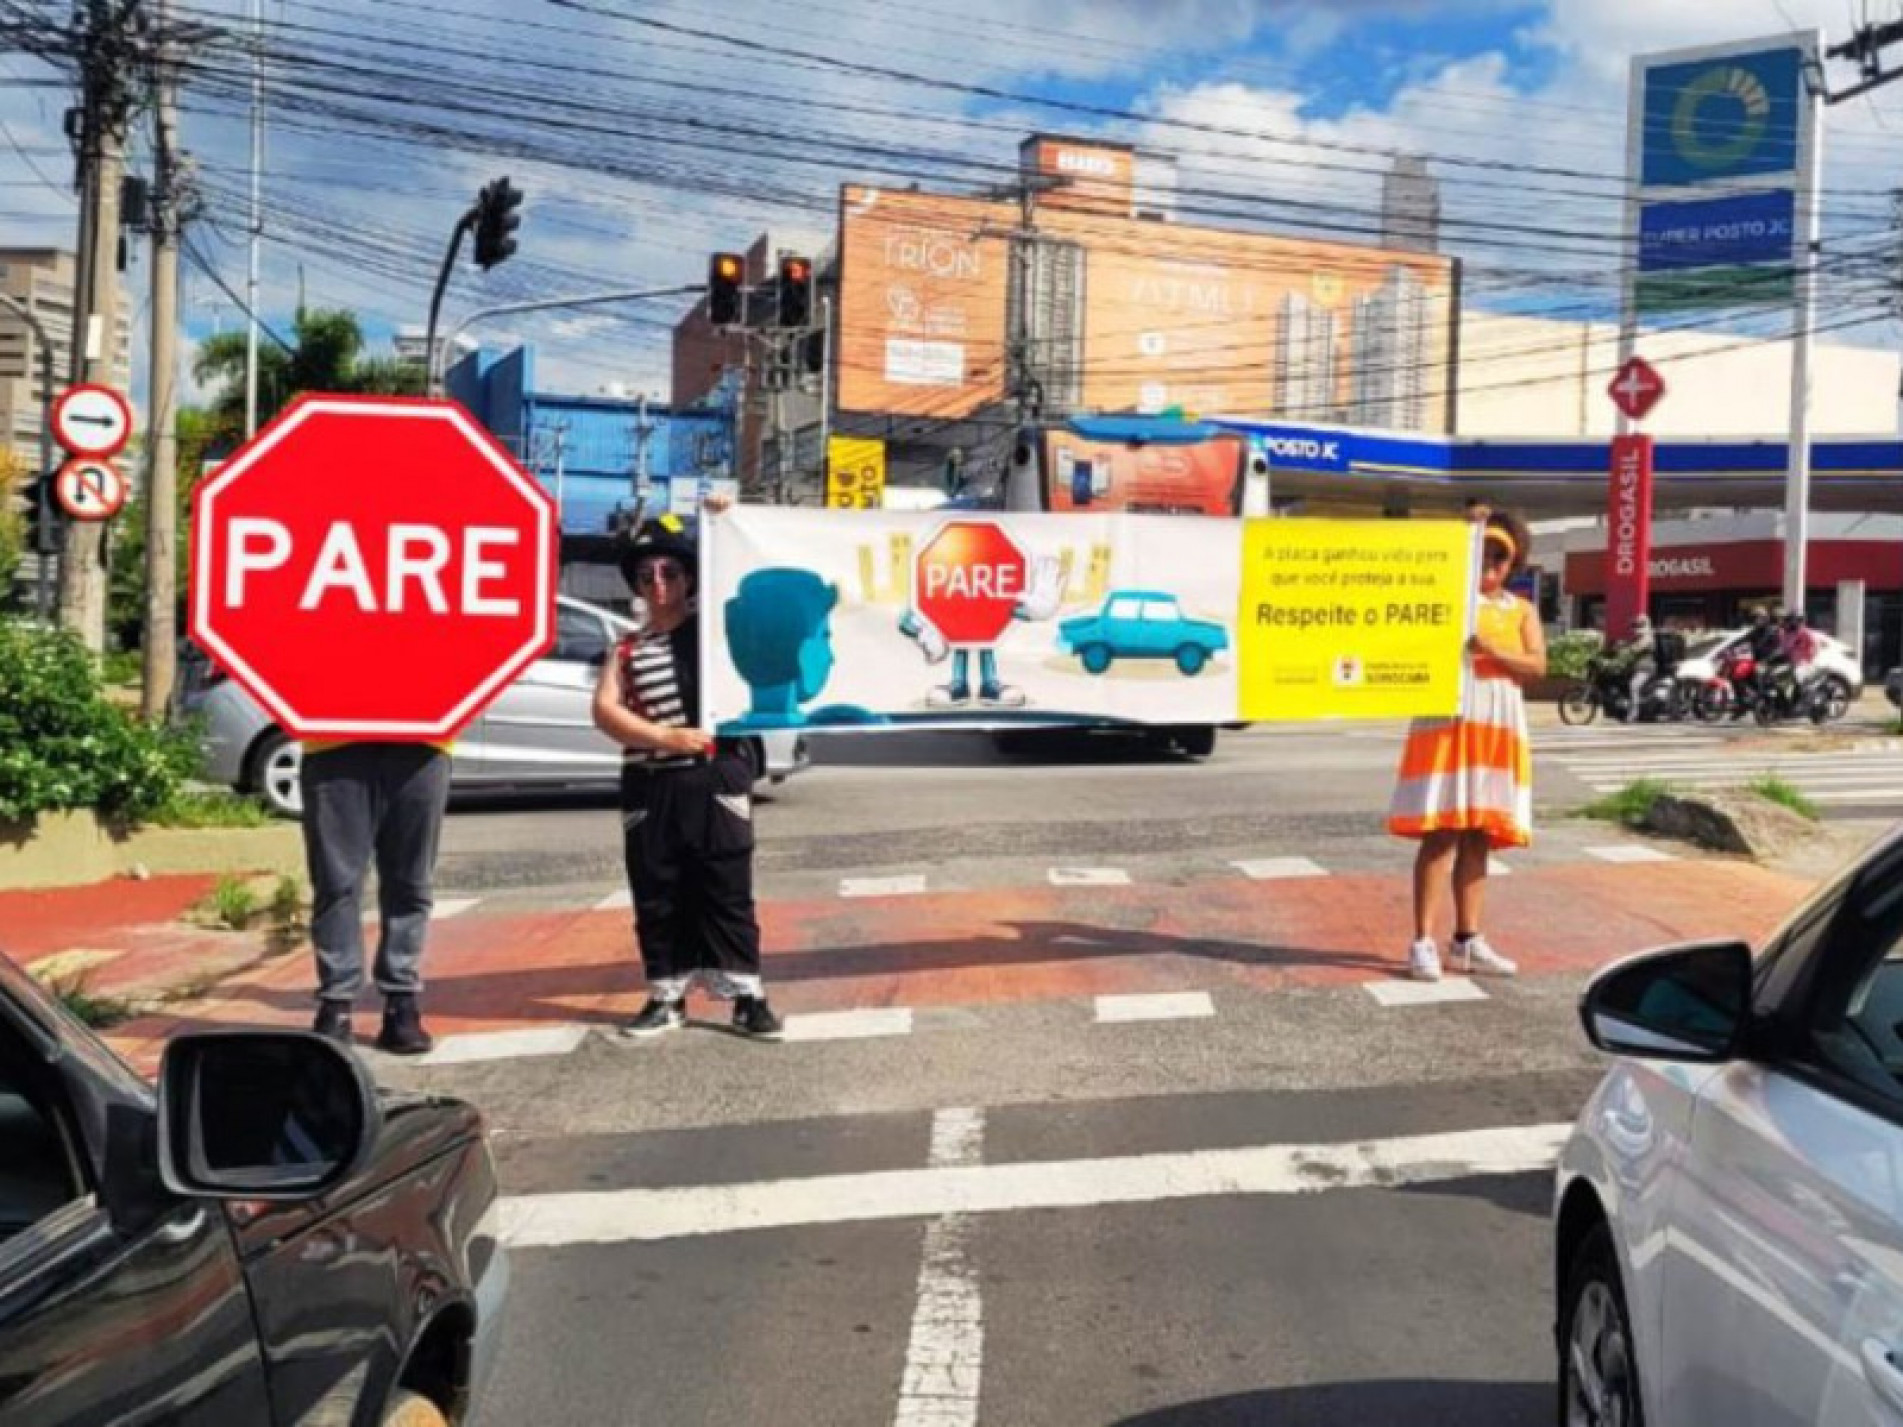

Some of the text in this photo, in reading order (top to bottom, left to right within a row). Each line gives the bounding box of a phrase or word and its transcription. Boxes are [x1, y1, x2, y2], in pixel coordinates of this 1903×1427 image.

[1616, 448, 1639, 575] DROGASIL
[225, 516, 522, 616] PARE
[1276, 546, 1319, 564] placa
[1322, 546, 1378, 565] ganhou
[925, 562, 1018, 601] PARE
[1271, 572, 1300, 587] que
[1303, 570, 1338, 586] você
[1340, 571, 1393, 588] proteja
[1256, 603, 1451, 630] Respeite o PARE!
